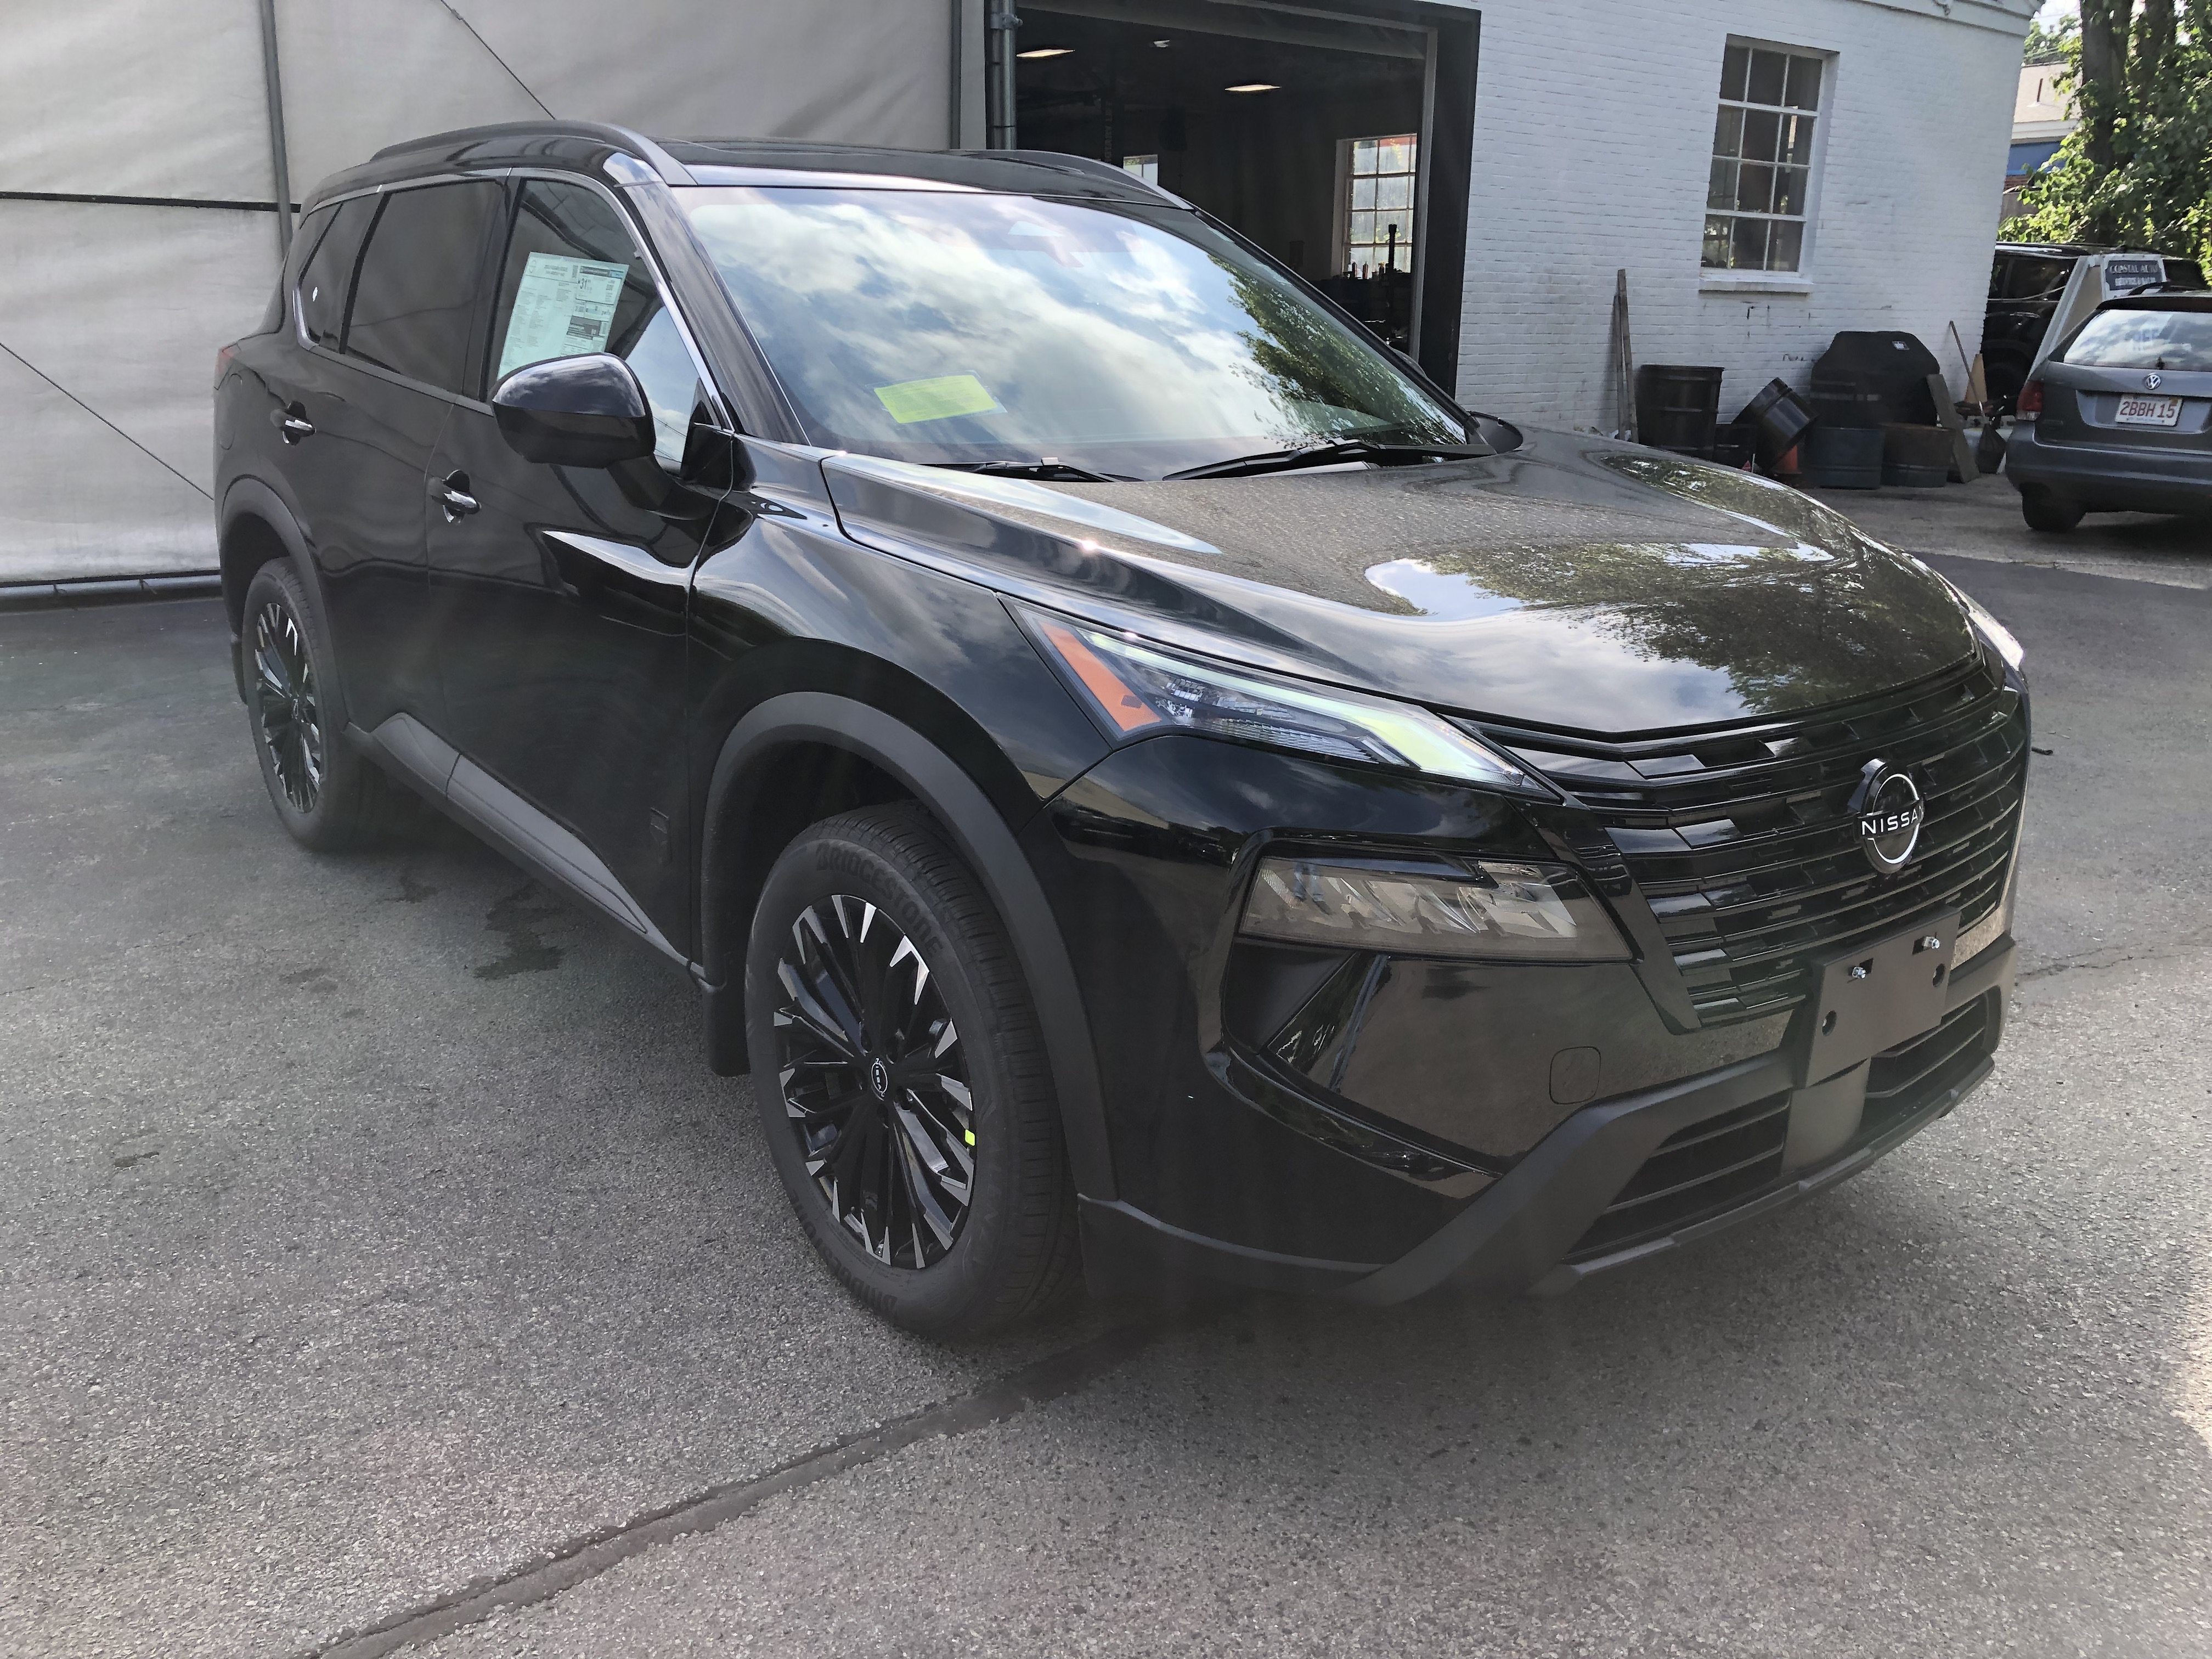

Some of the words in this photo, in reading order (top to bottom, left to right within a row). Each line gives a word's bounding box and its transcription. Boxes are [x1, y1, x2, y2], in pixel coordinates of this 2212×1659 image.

[2119, 401, 2156, 417] 2BBH
[2158, 403, 2177, 418] 15
[1861, 805, 1924, 835] NISSAN
